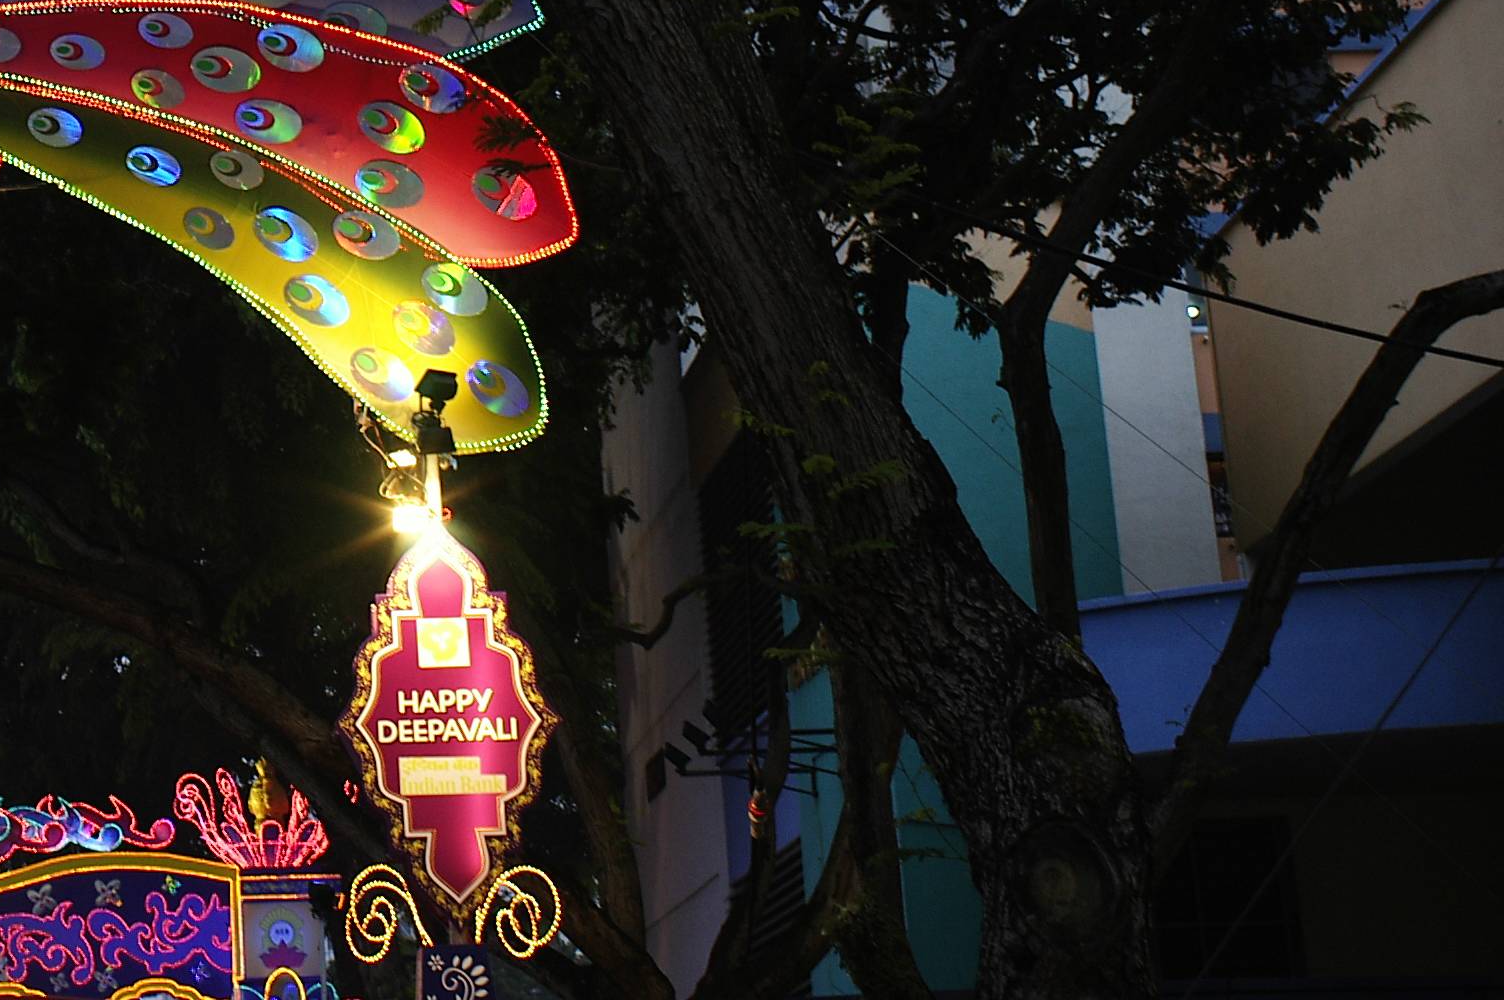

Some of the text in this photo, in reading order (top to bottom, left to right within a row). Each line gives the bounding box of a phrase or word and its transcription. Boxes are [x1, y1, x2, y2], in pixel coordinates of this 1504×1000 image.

[398, 689, 493, 713] HAPPY
[378, 717, 518, 743] DEEPAVALI
[402, 776, 503, 795] Indian Bank
